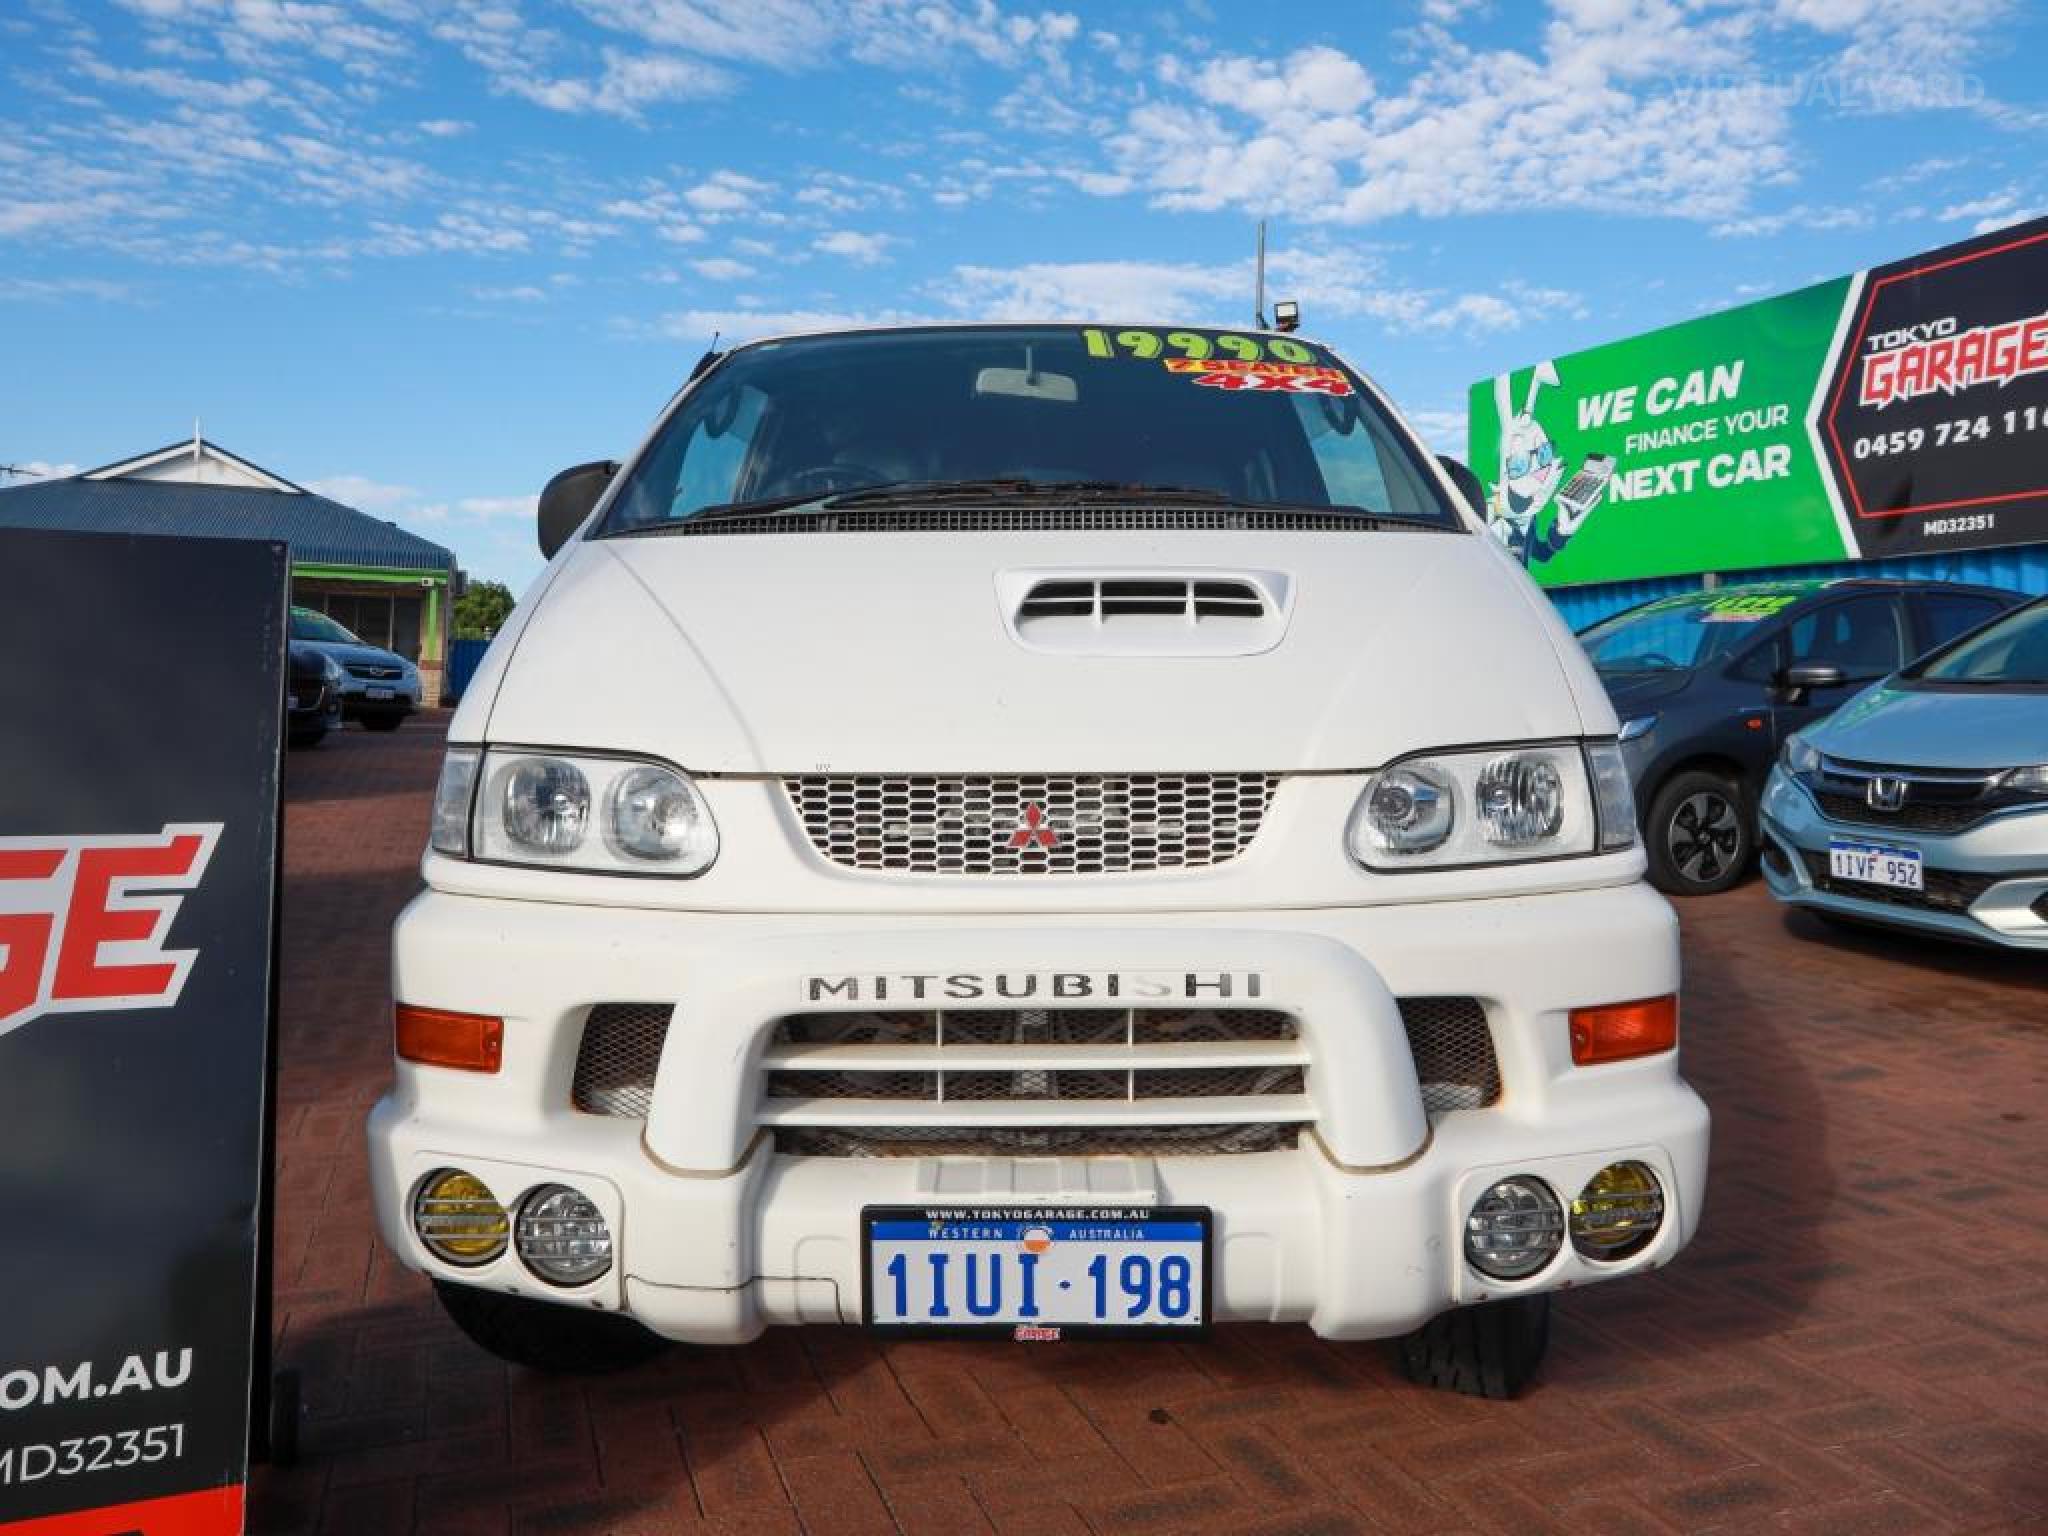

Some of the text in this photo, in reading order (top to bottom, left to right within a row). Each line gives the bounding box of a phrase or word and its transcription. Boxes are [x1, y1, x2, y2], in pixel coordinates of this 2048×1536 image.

[1083, 329, 1316, 364] 19990
[1867, 317, 1957, 350] TOKYO
[1859, 312, 2048, 410] GARAGE
[1577, 360, 1744, 431] WE CAN
[1625, 403, 1789, 455] FINANCE YOUR
[1854, 428, 1925, 459] 0459
[1935, 415, 1991, 447] 724
[1609, 444, 1791, 504] NEXT CAR
[1924, 514, 1995, 536] MD32351
[809, 973, 1262, 1000] MITSUBISHI
[926, 1209, 1150, 1219] WWW.TOKYOGARAGE.COM.AU
[928, 1227, 1145, 1240] WESTERN AUSTRALIA
